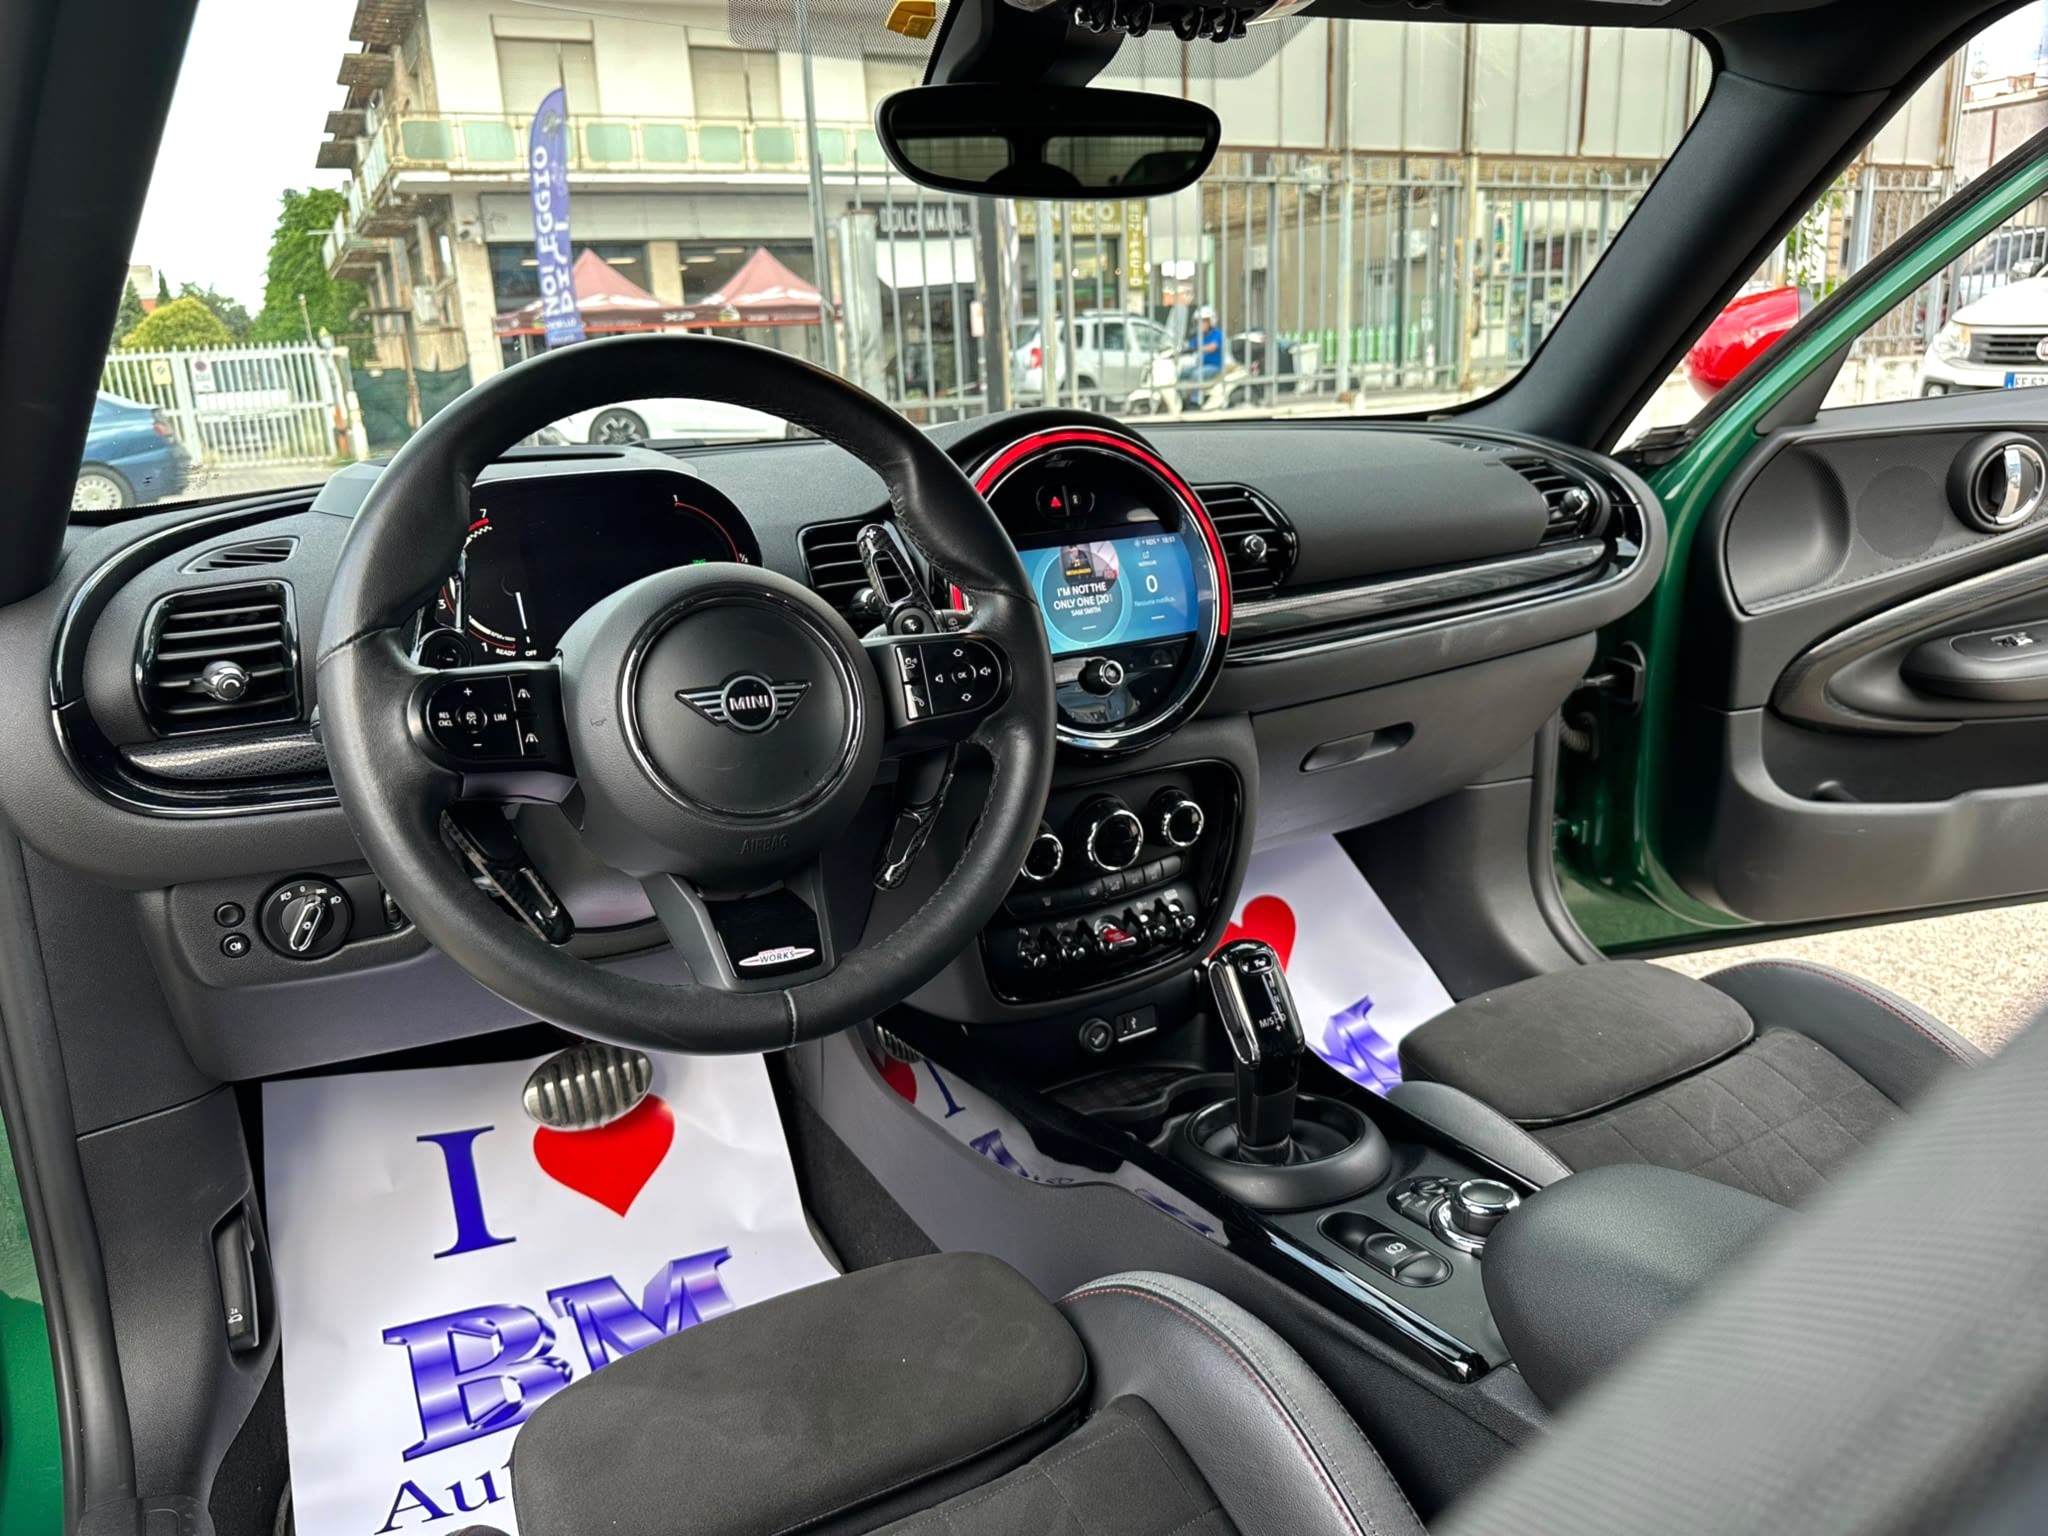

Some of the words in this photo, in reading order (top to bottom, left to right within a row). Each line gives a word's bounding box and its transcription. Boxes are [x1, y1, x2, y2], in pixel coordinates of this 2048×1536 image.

[479, 508, 487, 518] 7
[1057, 586, 1071, 598] I'M
[1071, 583, 1090, 596] NOT
[1090, 581, 1107, 593] THE
[1146, 574, 1158, 593] 0
[438, 599, 446, 609] 3
[1053, 598, 1076, 611] ONLY
[1076, 595, 1096, 607] ONE
[495, 648, 516, 657] READY
[525, 649, 537, 657] OFF
[729, 694, 770, 712] MINI
[493, 713, 507, 722] LIM
[740, 832, 789, 855] AIRBAG
[760, 950, 796, 964] WORKS
[416, 1125, 517, 1260] I
[374, 1460, 513, 1535] Au
